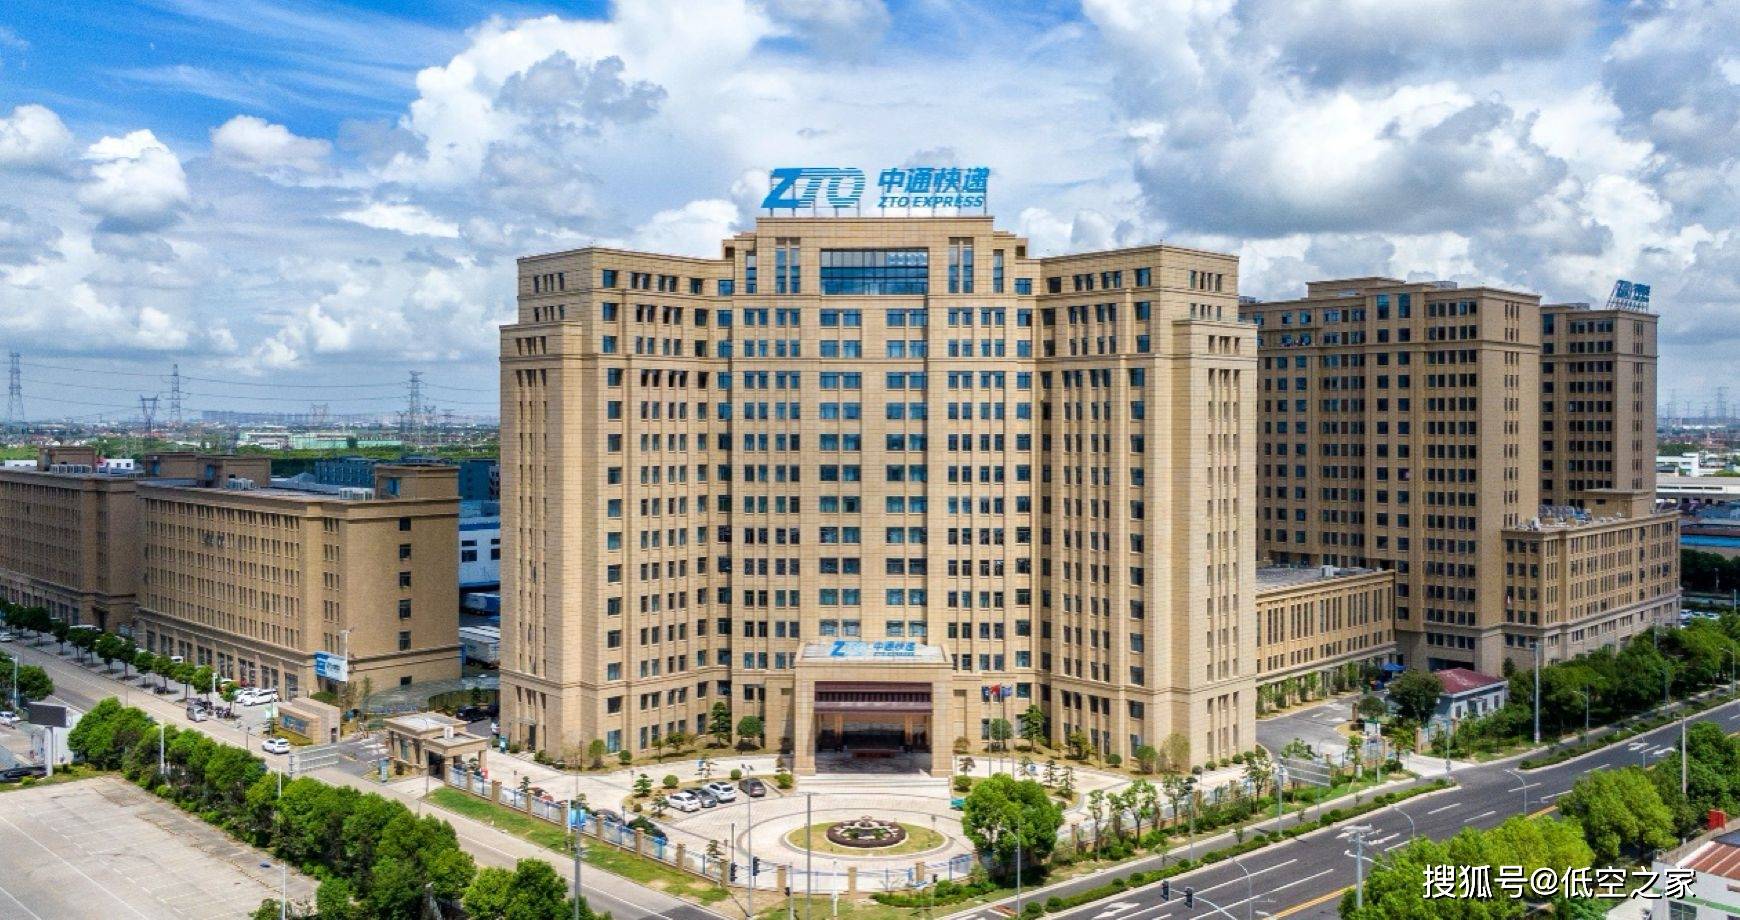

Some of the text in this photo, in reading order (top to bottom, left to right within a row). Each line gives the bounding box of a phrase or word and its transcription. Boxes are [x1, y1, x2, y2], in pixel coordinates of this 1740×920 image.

[761, 168, 865, 208] ZTO
[878, 167, 990, 193] 中通快递
[878, 196, 983, 207] ZTO EXPRESS
